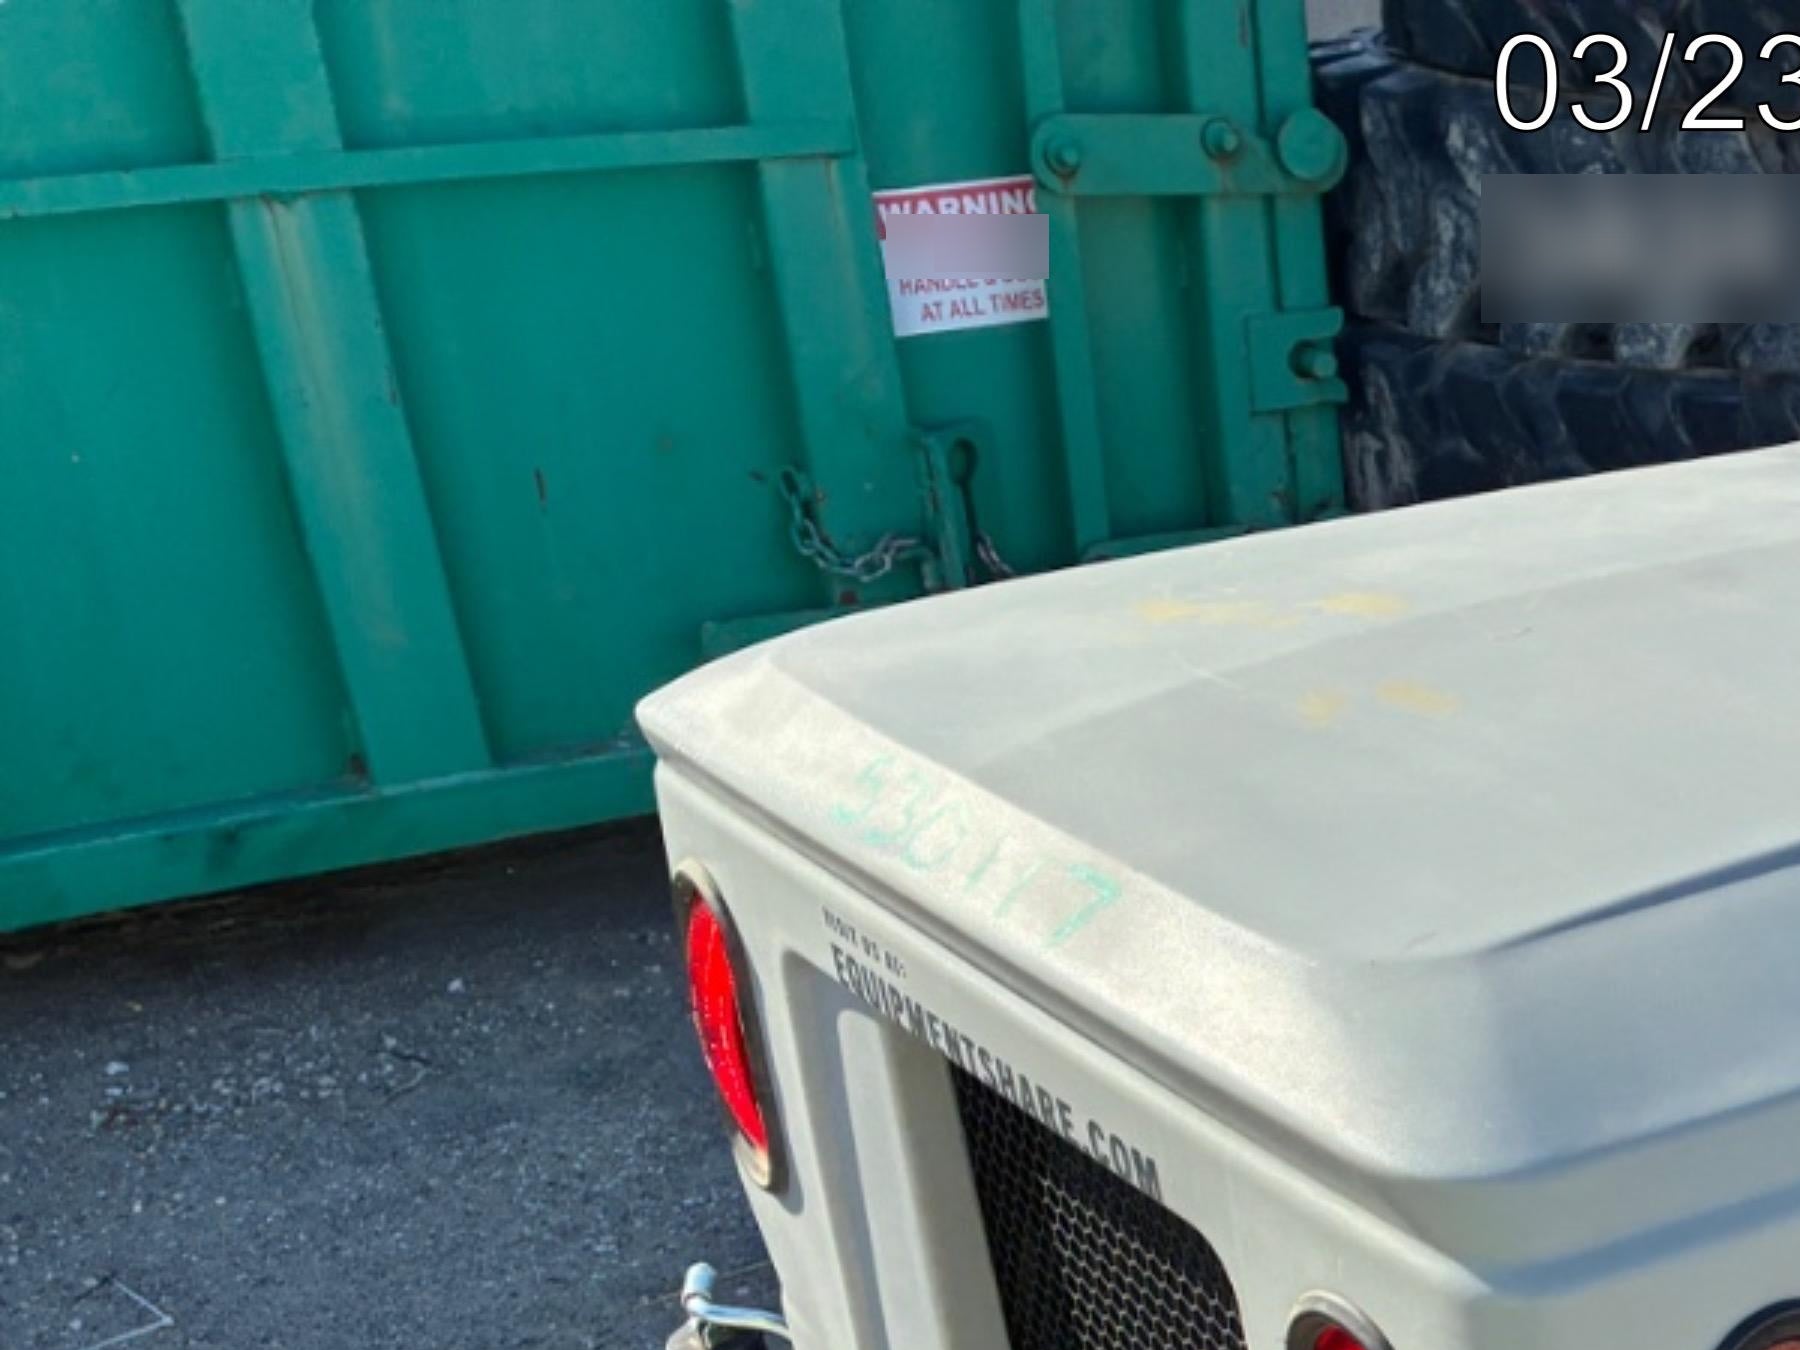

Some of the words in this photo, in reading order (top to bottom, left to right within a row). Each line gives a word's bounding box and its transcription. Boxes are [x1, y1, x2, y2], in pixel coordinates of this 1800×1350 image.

[920, 301, 943, 323] AT
[950, 297, 986, 321] ALL
[989, 290, 1044, 313] TIMES
[830, 942, 1163, 1204] EQUIPMENTSHARE.COM
